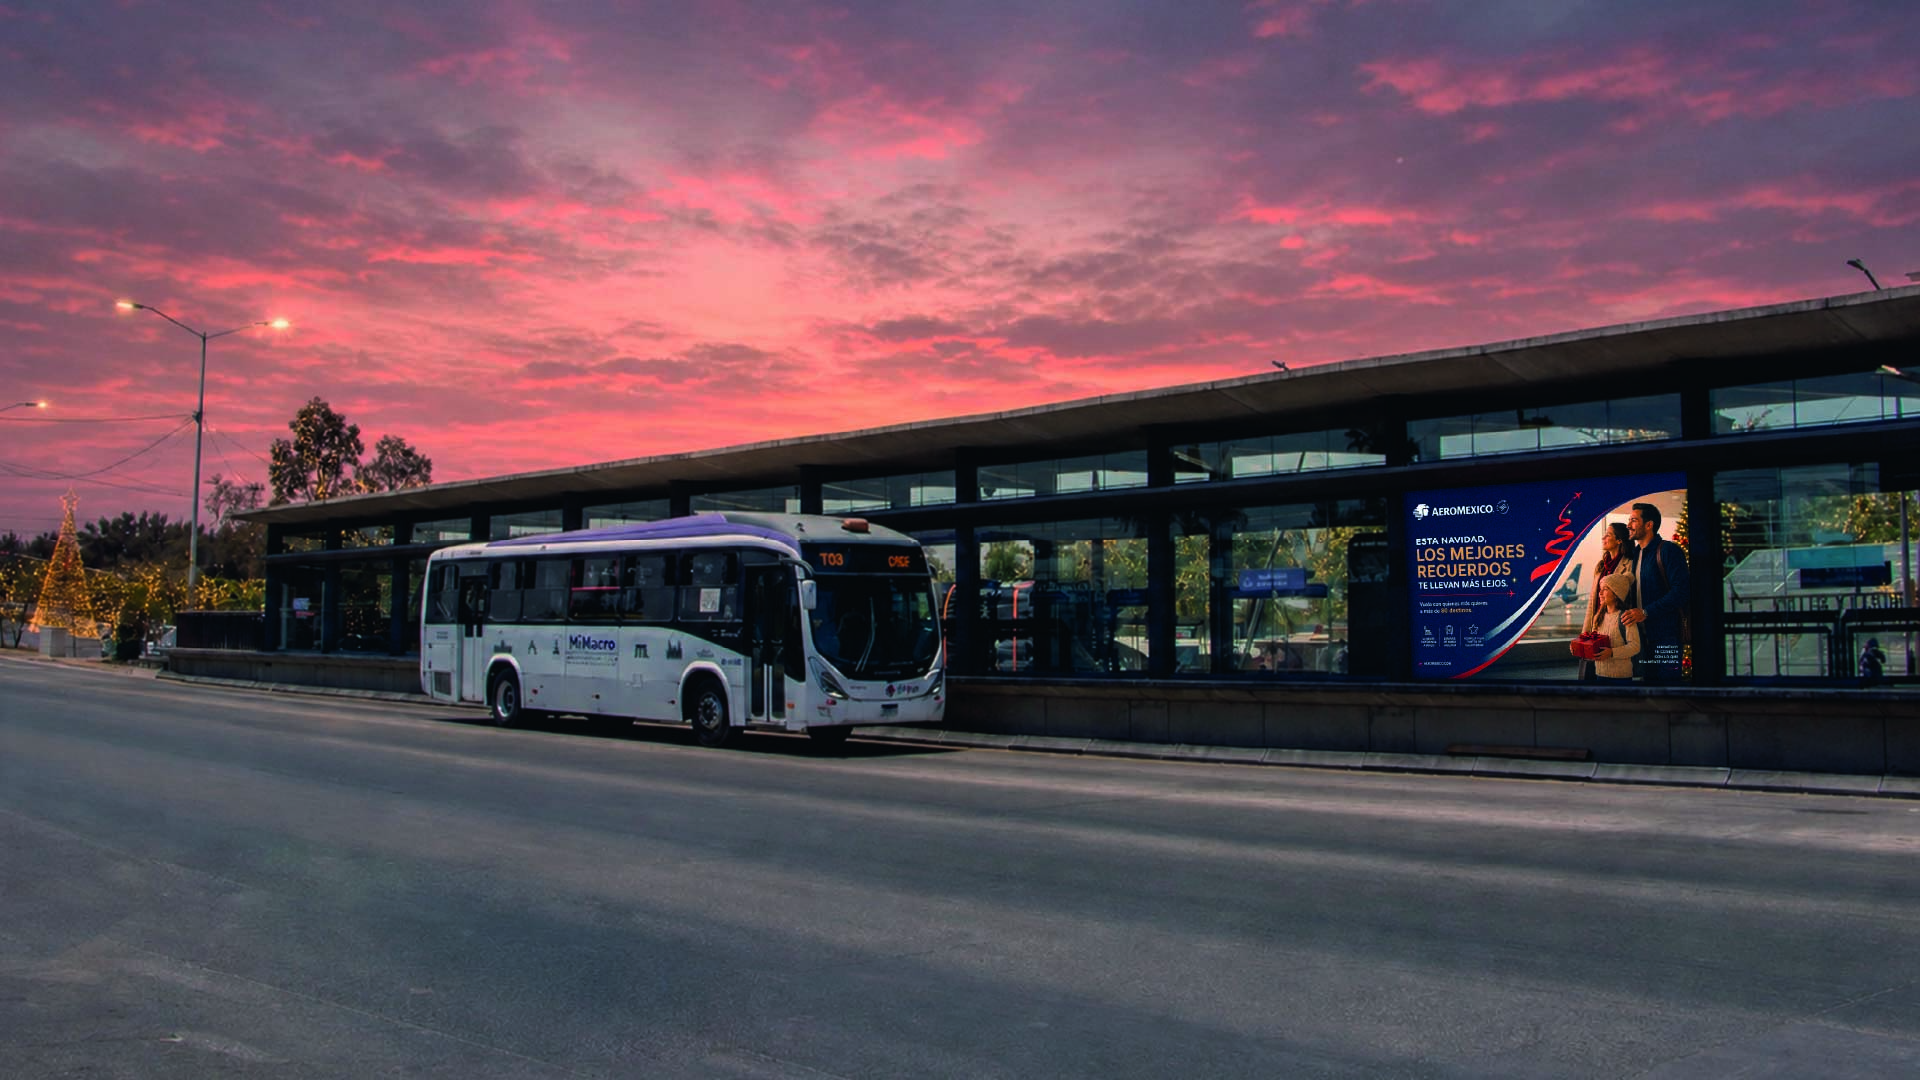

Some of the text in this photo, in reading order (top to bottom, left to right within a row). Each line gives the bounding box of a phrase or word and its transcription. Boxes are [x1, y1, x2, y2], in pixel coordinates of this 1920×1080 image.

[1432, 504, 1493, 516] AEROMEXICO
[1415, 535, 1487, 546] ESTA NAVIDAD,
[819, 552, 844, 566] T03
[1416, 543, 1525, 562] LOS MEJORES
[1417, 561, 1511, 578] RECUERDOS
[1418, 578, 1509, 590] TE LLEVAN MÁS LEJOS.
[569, 634, 616, 651] MiMacro
